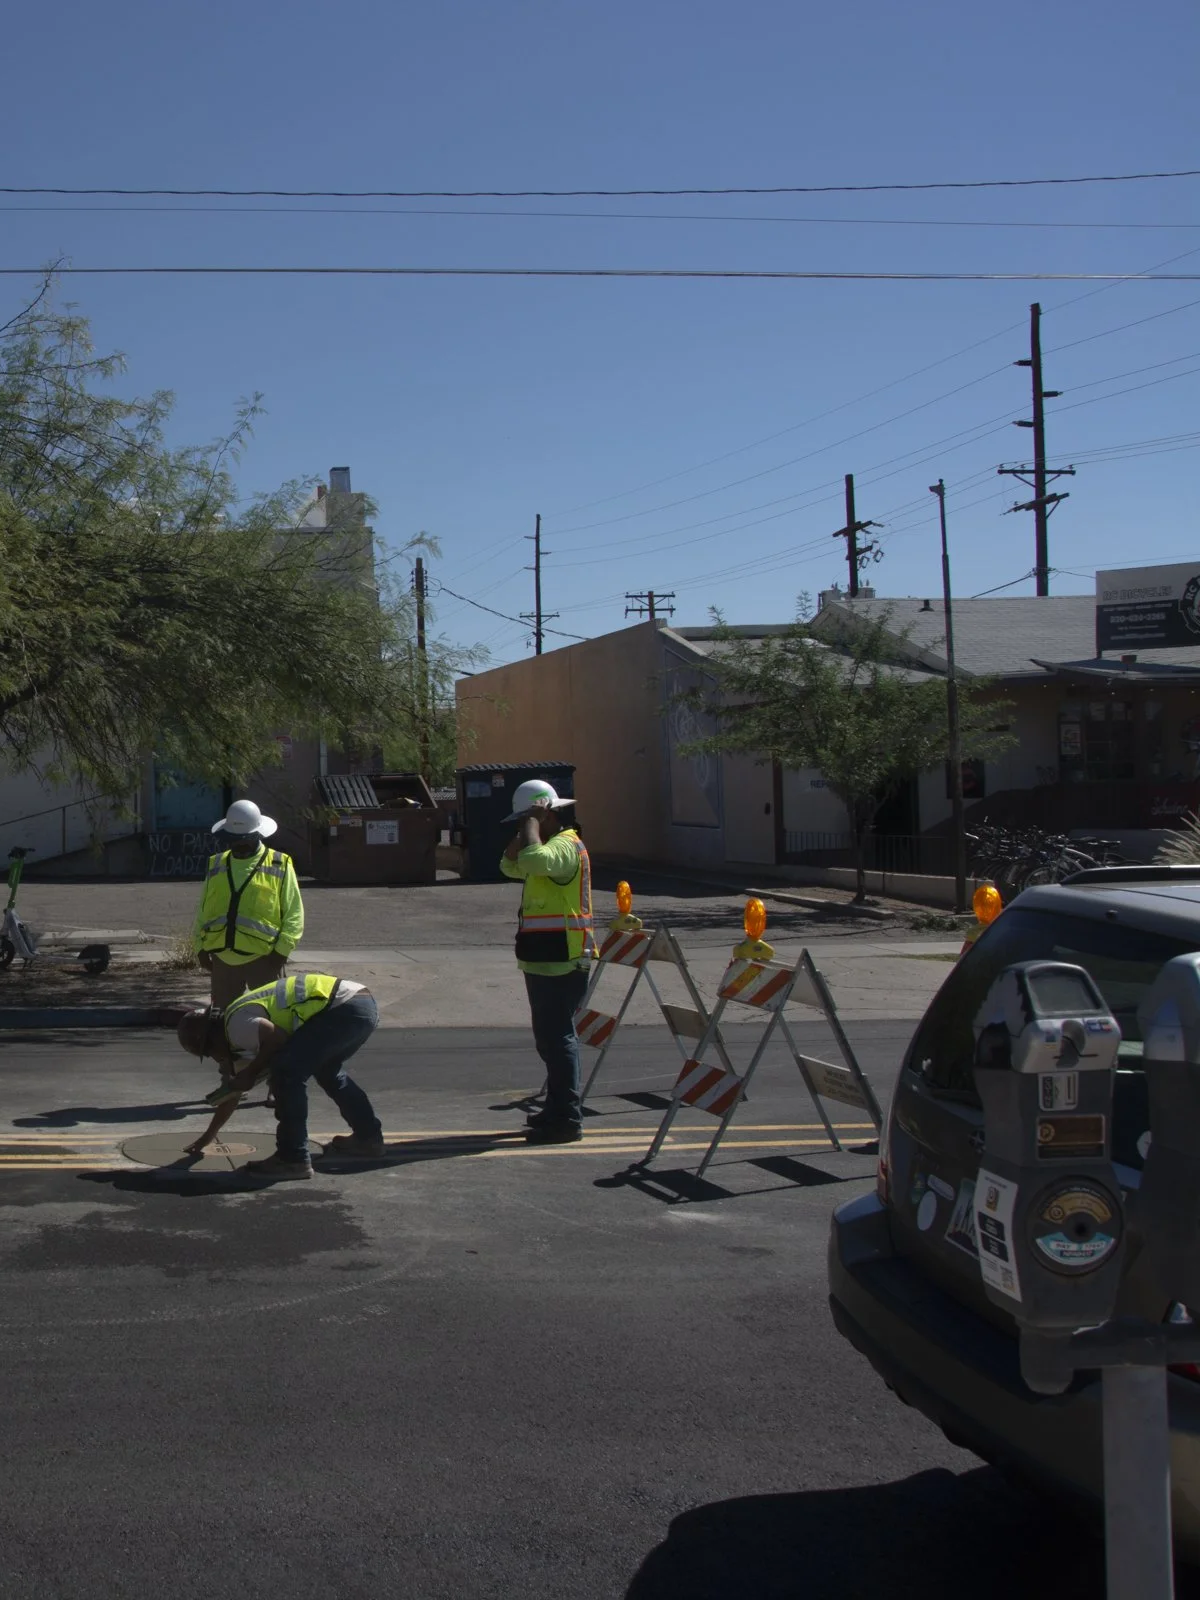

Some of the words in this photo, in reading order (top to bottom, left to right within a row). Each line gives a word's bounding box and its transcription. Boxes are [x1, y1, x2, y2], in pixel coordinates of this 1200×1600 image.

[148, 834, 171, 853] NO
[182, 832, 228, 854] PARK
[150, 853, 209, 876] LOADI
